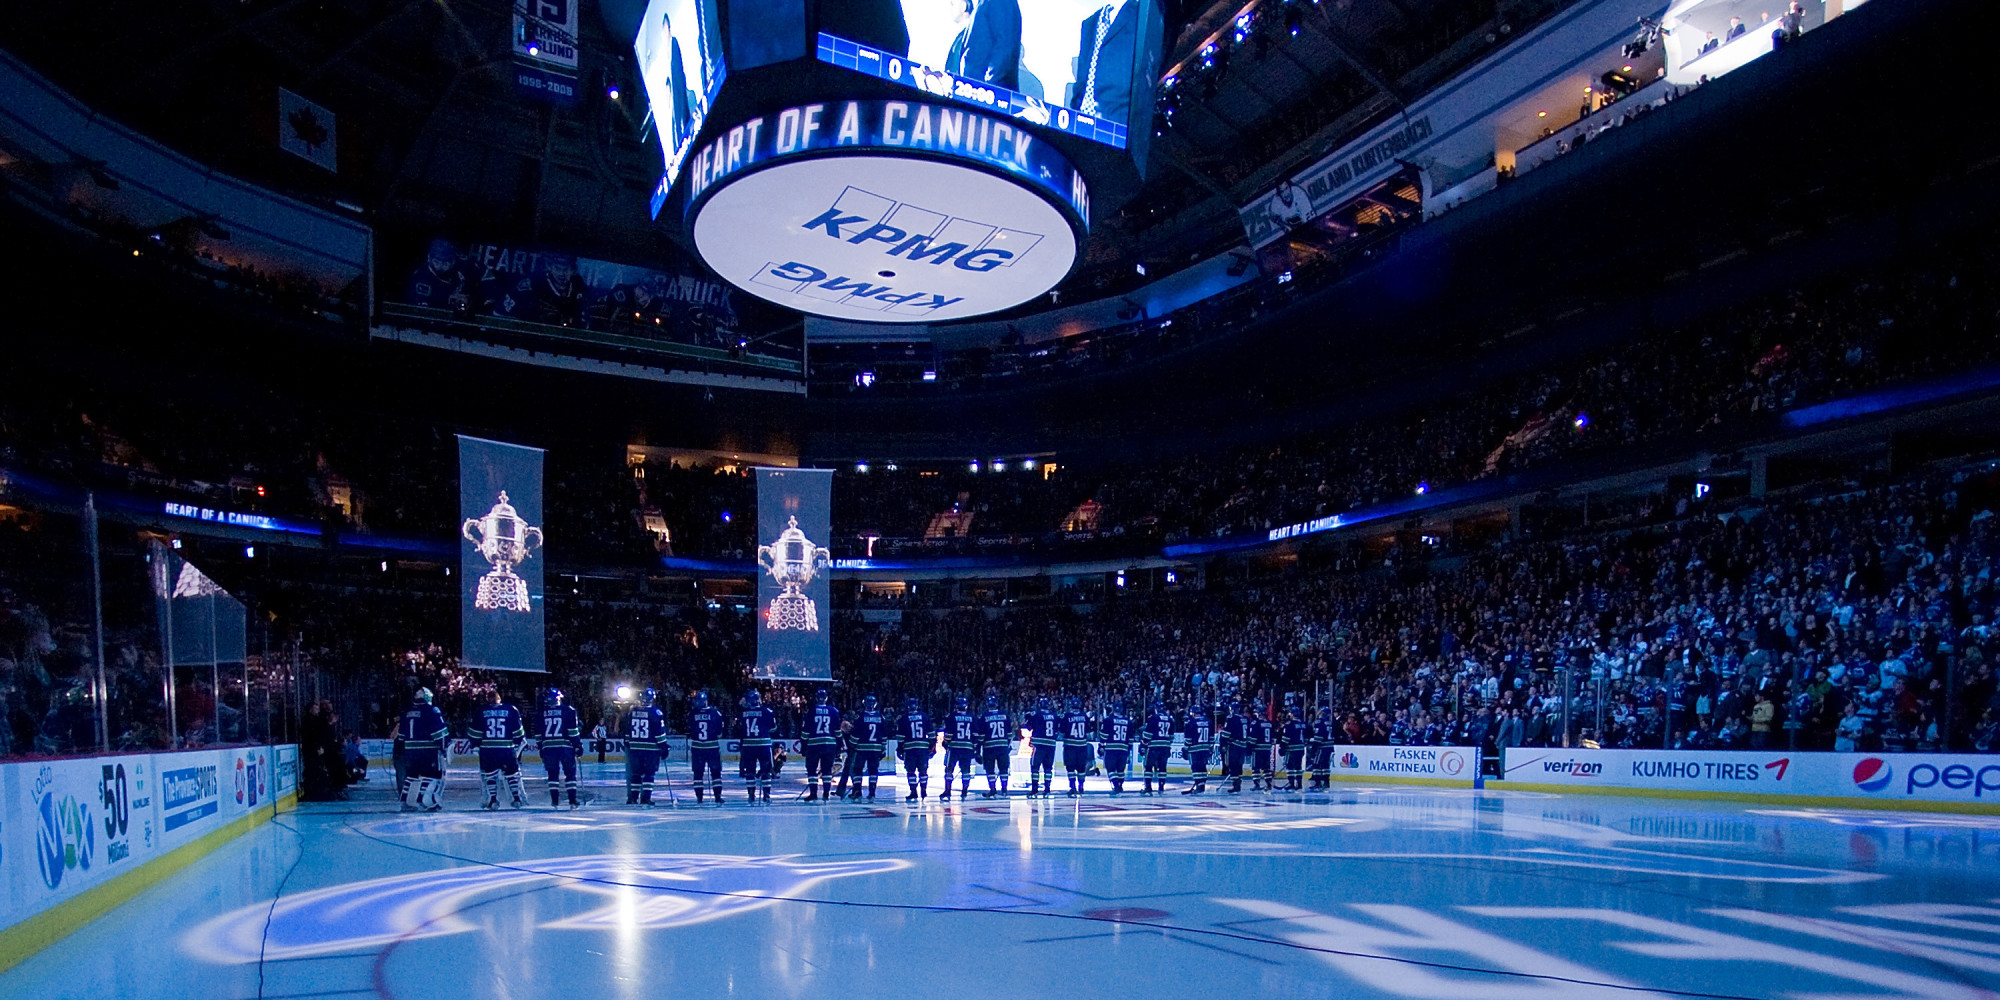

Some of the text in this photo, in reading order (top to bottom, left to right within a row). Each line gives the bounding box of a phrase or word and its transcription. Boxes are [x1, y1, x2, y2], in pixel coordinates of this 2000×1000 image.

[888, 58, 902, 80] 0
[1057, 109, 1069, 130] 0
[691, 101, 1033, 200] HEART OF A CANUCK
[803, 207, 1015, 273] KPMG
[468, 244, 541, 274] HEART
[769, 260, 964, 310] KPMG
[165, 502, 270, 529] HEART OF A CANUCK
[1269, 515, 1339, 540] HEART OF A CANUCK
[836, 559, 868, 569] CANUCK
[409, 718, 414, 739] 1
[486, 718, 506, 738] 35
[544, 717, 563, 737] 22
[631, 719, 650, 738] 33
[698, 721, 708, 740] 3
[745, 717, 760, 737] 14
[814, 715, 831, 734] 23
[868, 723, 877, 741] 2
[910, 721, 924, 739] 15
[957, 722, 971, 740] 54
[989, 721, 1005, 739] 26
[1045, 721, 1054, 737] 8
[1070, 722, 1085, 738] 40
[1113, 725, 1127, 741] 36
[1197, 727, 1209, 743] 20
[1264, 728, 1271, 743] 9
[1393, 748, 1436, 760] FASKEN
[1369, 760, 1436, 773] MARTINEAU
[1544, 758, 1602, 776] verizon
[1632, 761, 1759, 780] KUMHO TIRES
